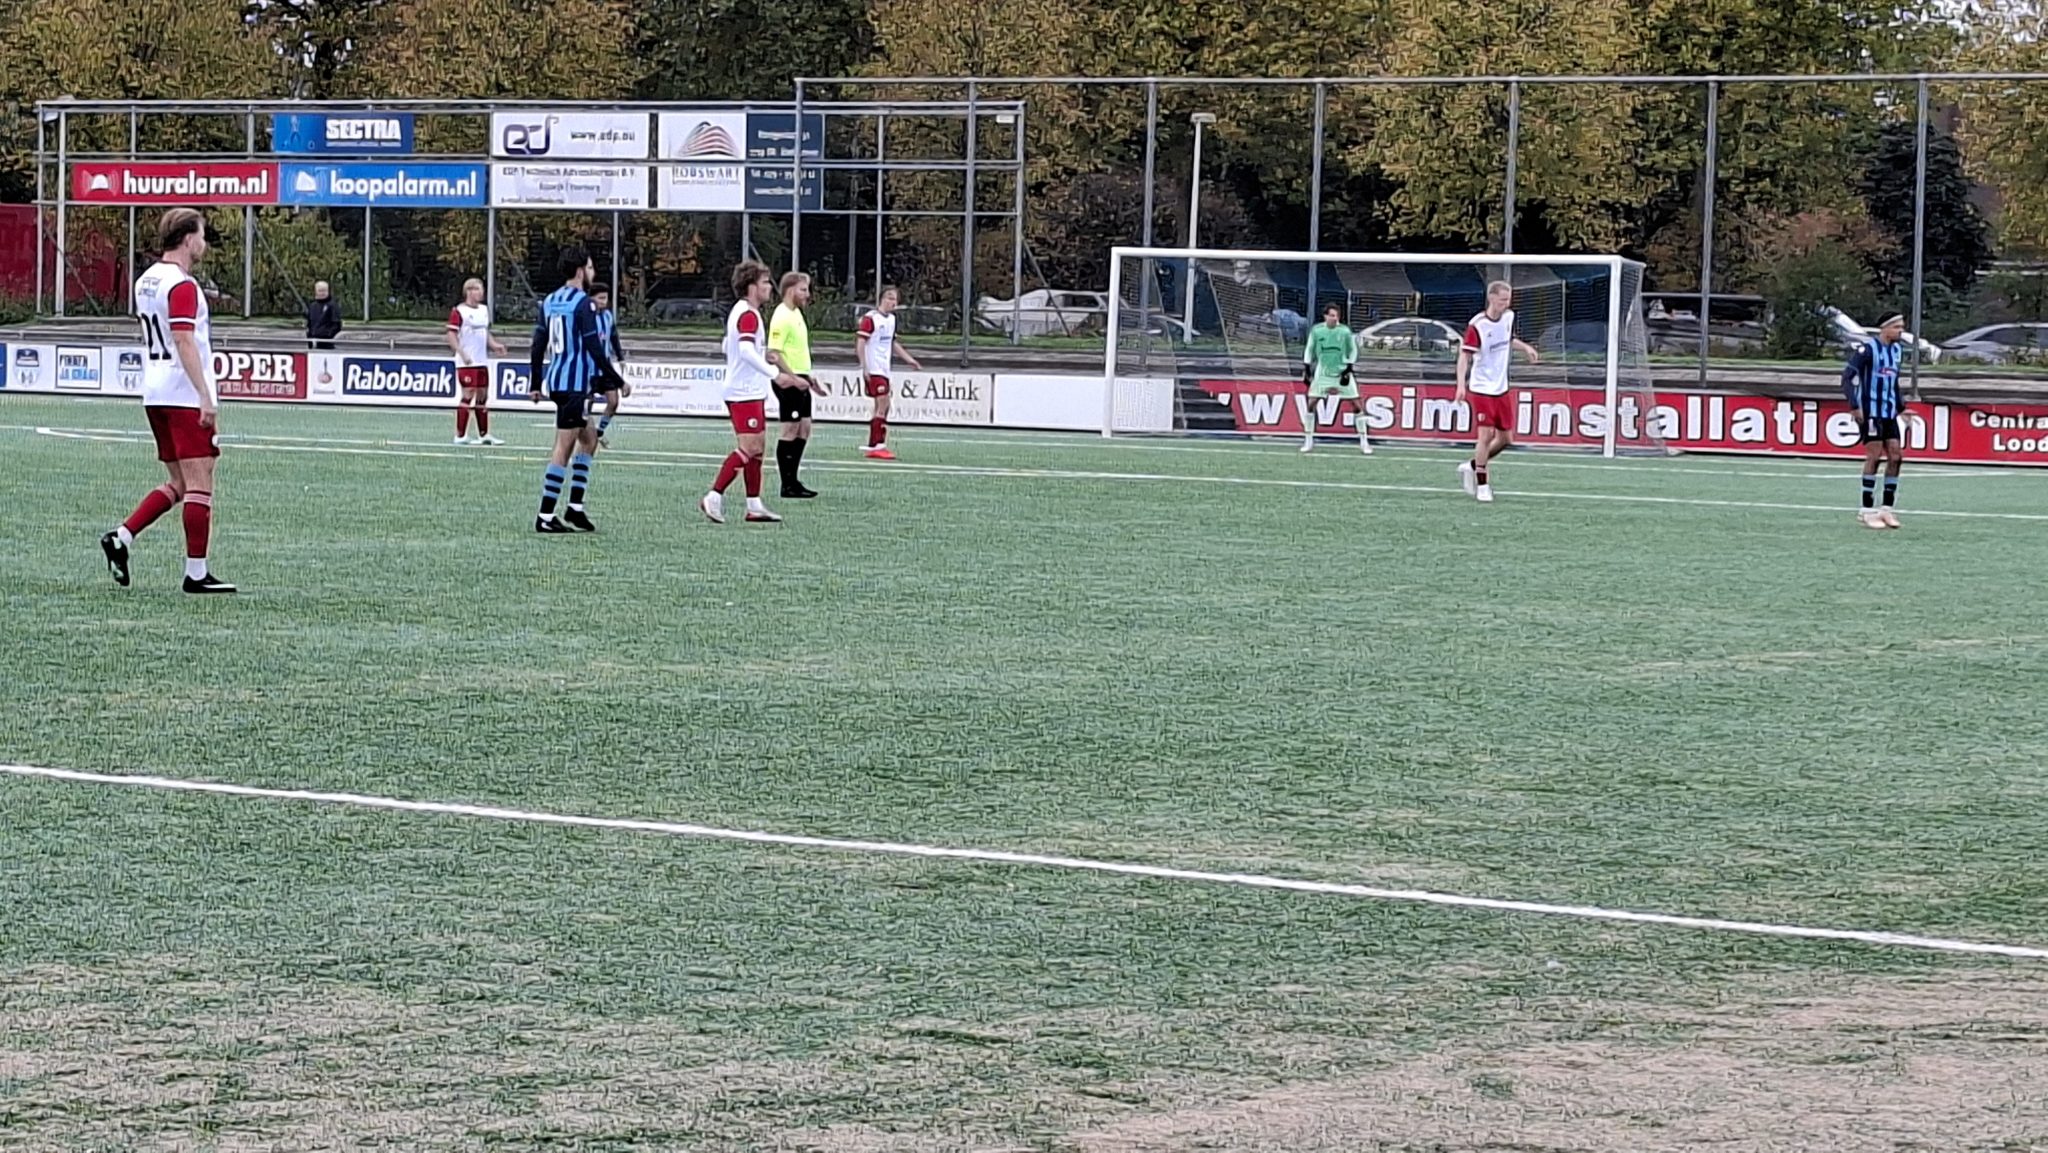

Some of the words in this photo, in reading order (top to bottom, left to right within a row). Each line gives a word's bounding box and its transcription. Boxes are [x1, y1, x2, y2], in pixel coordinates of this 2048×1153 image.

[326, 119, 401, 140] SECTRA
[123, 169, 268, 195] huuralarm.nl
[330, 170, 476, 201] koopalarm.nl
[211, 352, 296, 382] OPER
[346, 364, 452, 394] Rabobank
[901, 380, 918, 398] &
[923, 377, 980, 400] Alink
